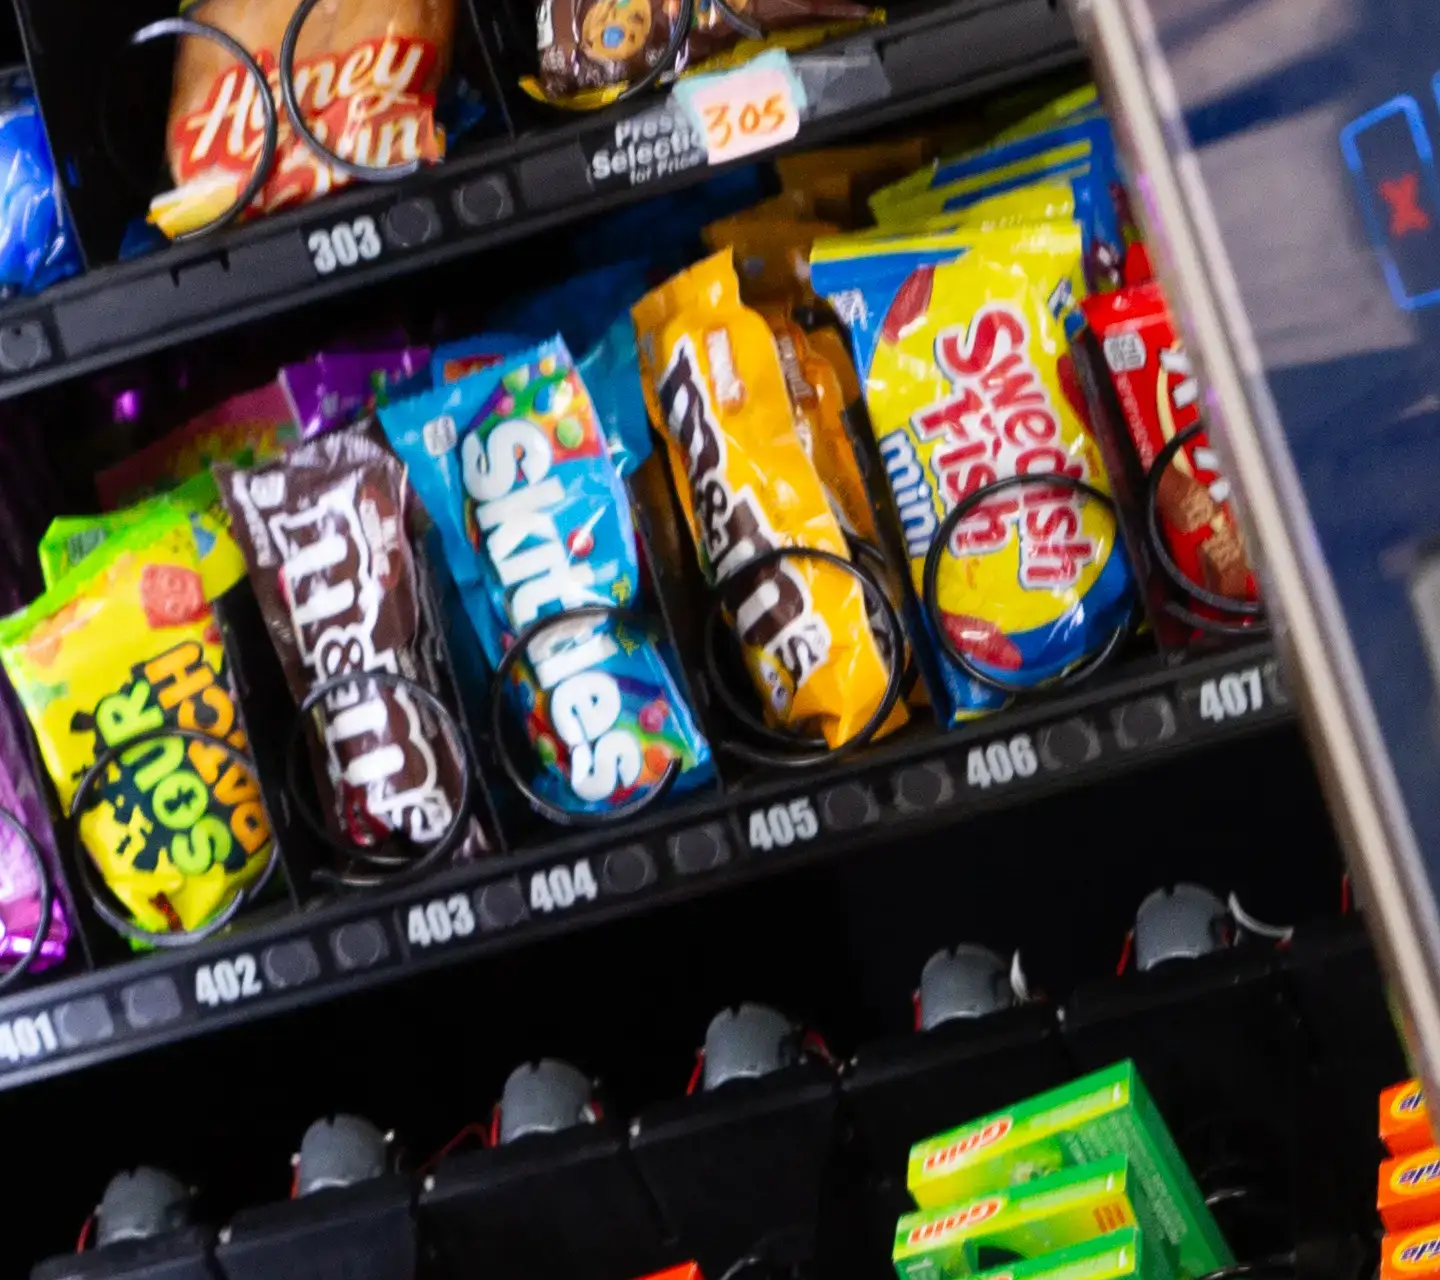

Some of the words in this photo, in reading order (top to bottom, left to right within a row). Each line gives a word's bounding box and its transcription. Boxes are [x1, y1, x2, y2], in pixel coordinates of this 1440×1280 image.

[703, 94, 787, 149] 305
[592, 129, 704, 180] Selectio
[630, 166, 650, 185] for
[658, 152, 700, 178] Price
[308, 216, 382, 274] 303
[917, 392, 1010, 555] Fish
[939, 311, 1091, 587] Swedish
[1198, 669, 1264, 722] 407
[143, 642, 270, 855] PATCH
[966, 736, 1038, 789] 406
[98, 679, 232, 875] SOUR
[748, 798, 818, 852] 405
[529, 861, 598, 912] 404
[407, 895, 476, 947] 403
[194, 956, 262, 1006] 402
[925, 1119, 1011, 1170] Gain
[909, 1201, 1000, 1242] Gain
